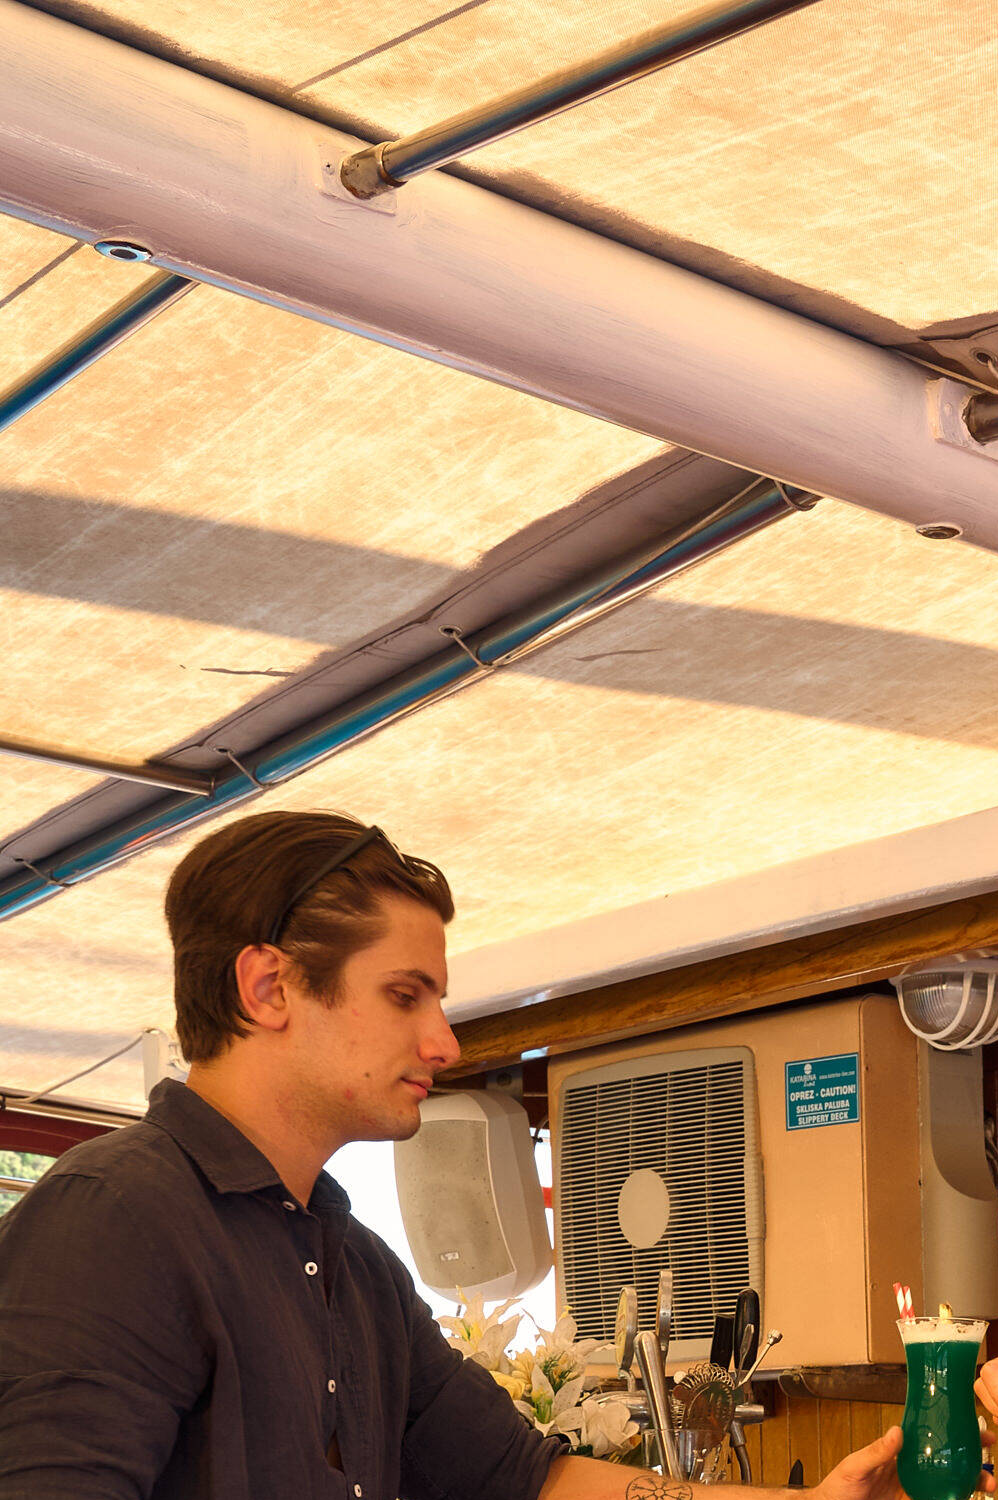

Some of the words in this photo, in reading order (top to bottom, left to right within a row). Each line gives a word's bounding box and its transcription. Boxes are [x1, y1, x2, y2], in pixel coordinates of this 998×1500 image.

[790, 1090, 815, 1102] OPREZ
[820, 1084, 856, 1098] CAUTION!
[796, 1103, 823, 1114] SKLISKA
[824, 1099, 850, 1110] PALUBA
[798, 1114, 829, 1125] SLIPPERY
[830, 1112, 849, 1121] DECK
